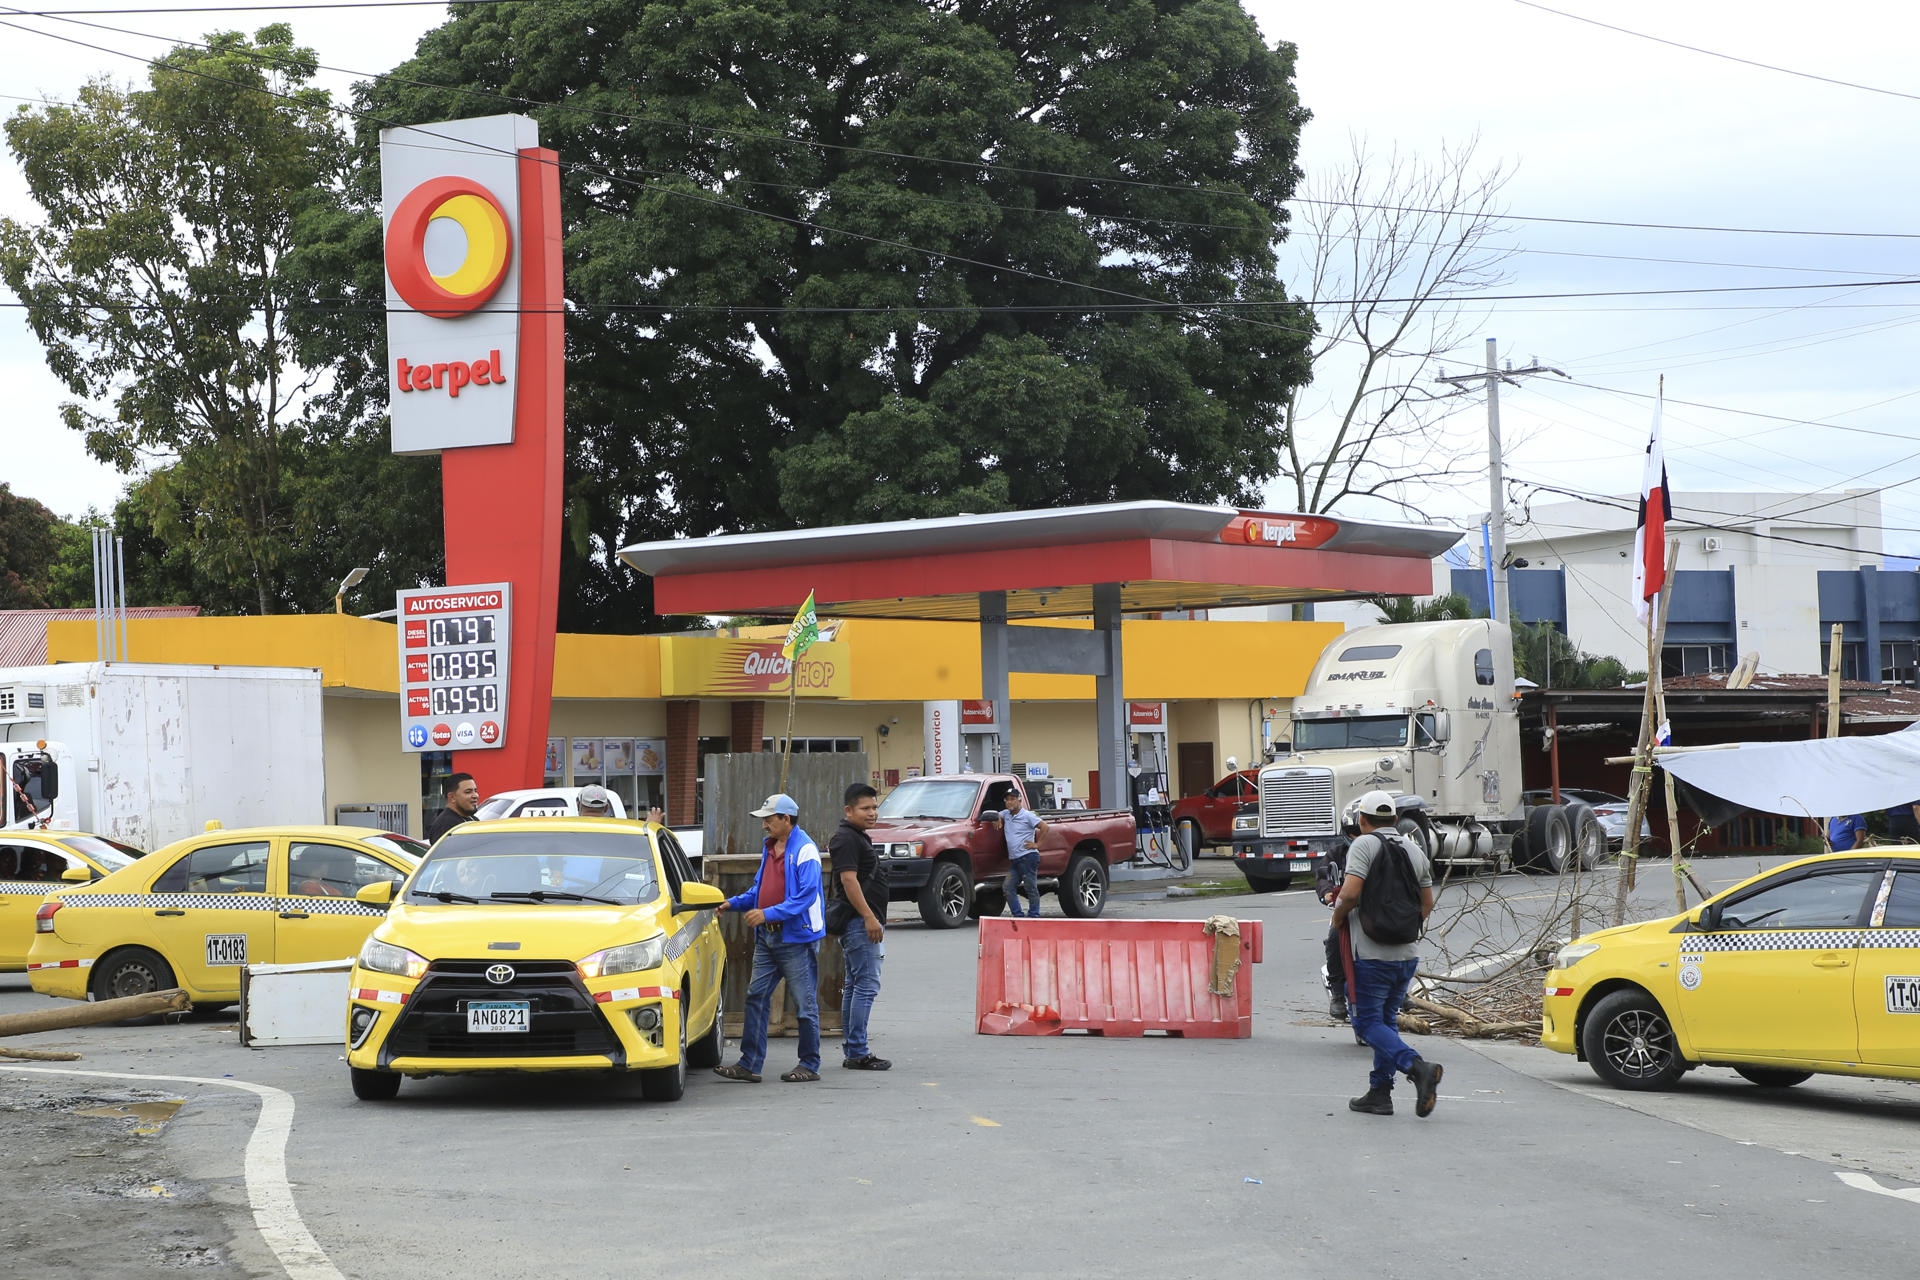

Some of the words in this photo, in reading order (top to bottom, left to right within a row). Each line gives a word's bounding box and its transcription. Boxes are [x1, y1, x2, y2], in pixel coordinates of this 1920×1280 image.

[397, 349, 506, 397] terpel
[1262, 521, 1296, 546] terpel
[410, 594, 499, 612] AUTOSERVICIO
[432, 617, 495, 646] 0.797
[432, 651, 496, 681] 0.895
[433, 685, 497, 715] 0.950
[457, 730, 473, 738] VISA
[481, 725, 495, 735] 24
[932, 710, 942, 774] utoservicio
[207, 939, 245, 961] 1T-0183
[472, 1009, 525, 1025] AN0821
